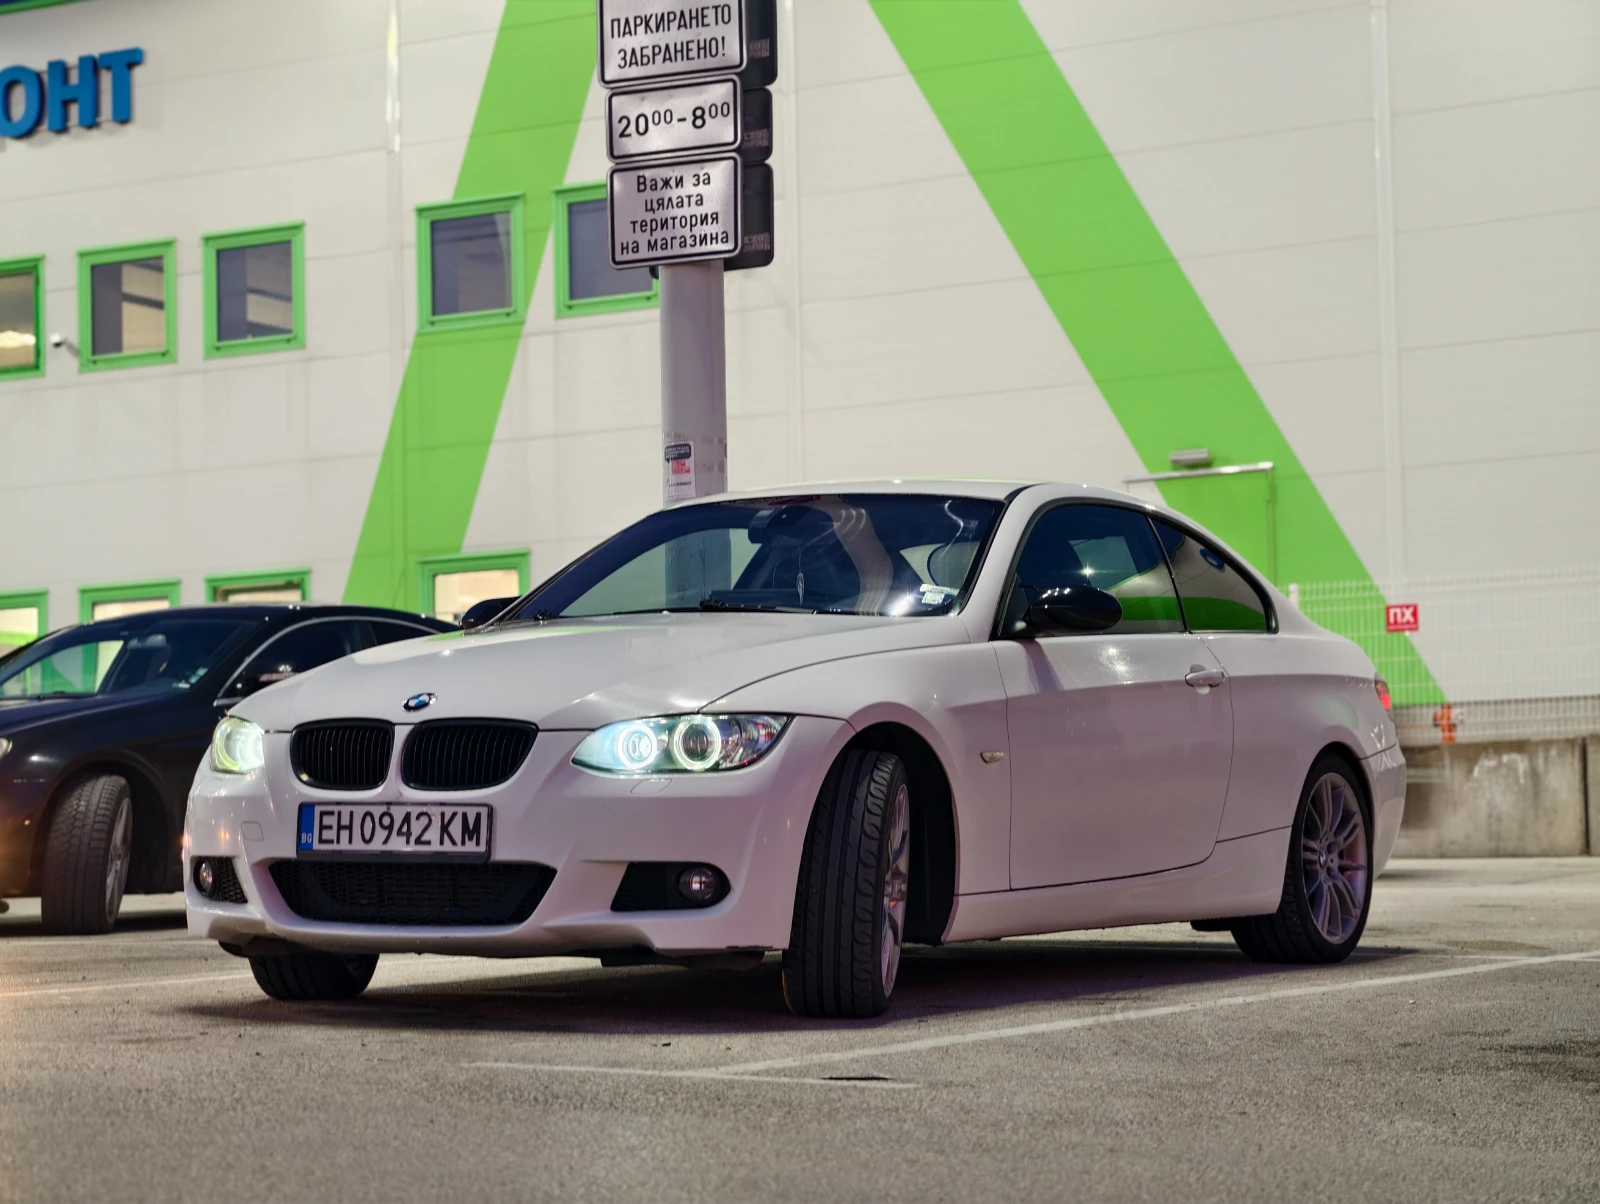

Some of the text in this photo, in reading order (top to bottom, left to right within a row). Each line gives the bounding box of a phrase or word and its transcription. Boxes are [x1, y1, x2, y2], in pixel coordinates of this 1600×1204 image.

[610, 4, 731, 39] ПАРКИРАНЕТО
[617, 36, 726, 69] ЗАБРАНЕНО!
[637, 172, 711, 193] Важи за
[645, 193, 704, 215] цялата
[630, 212, 719, 236] територия
[620, 240, 640, 255] на
[647, 230, 729, 253] магазина
